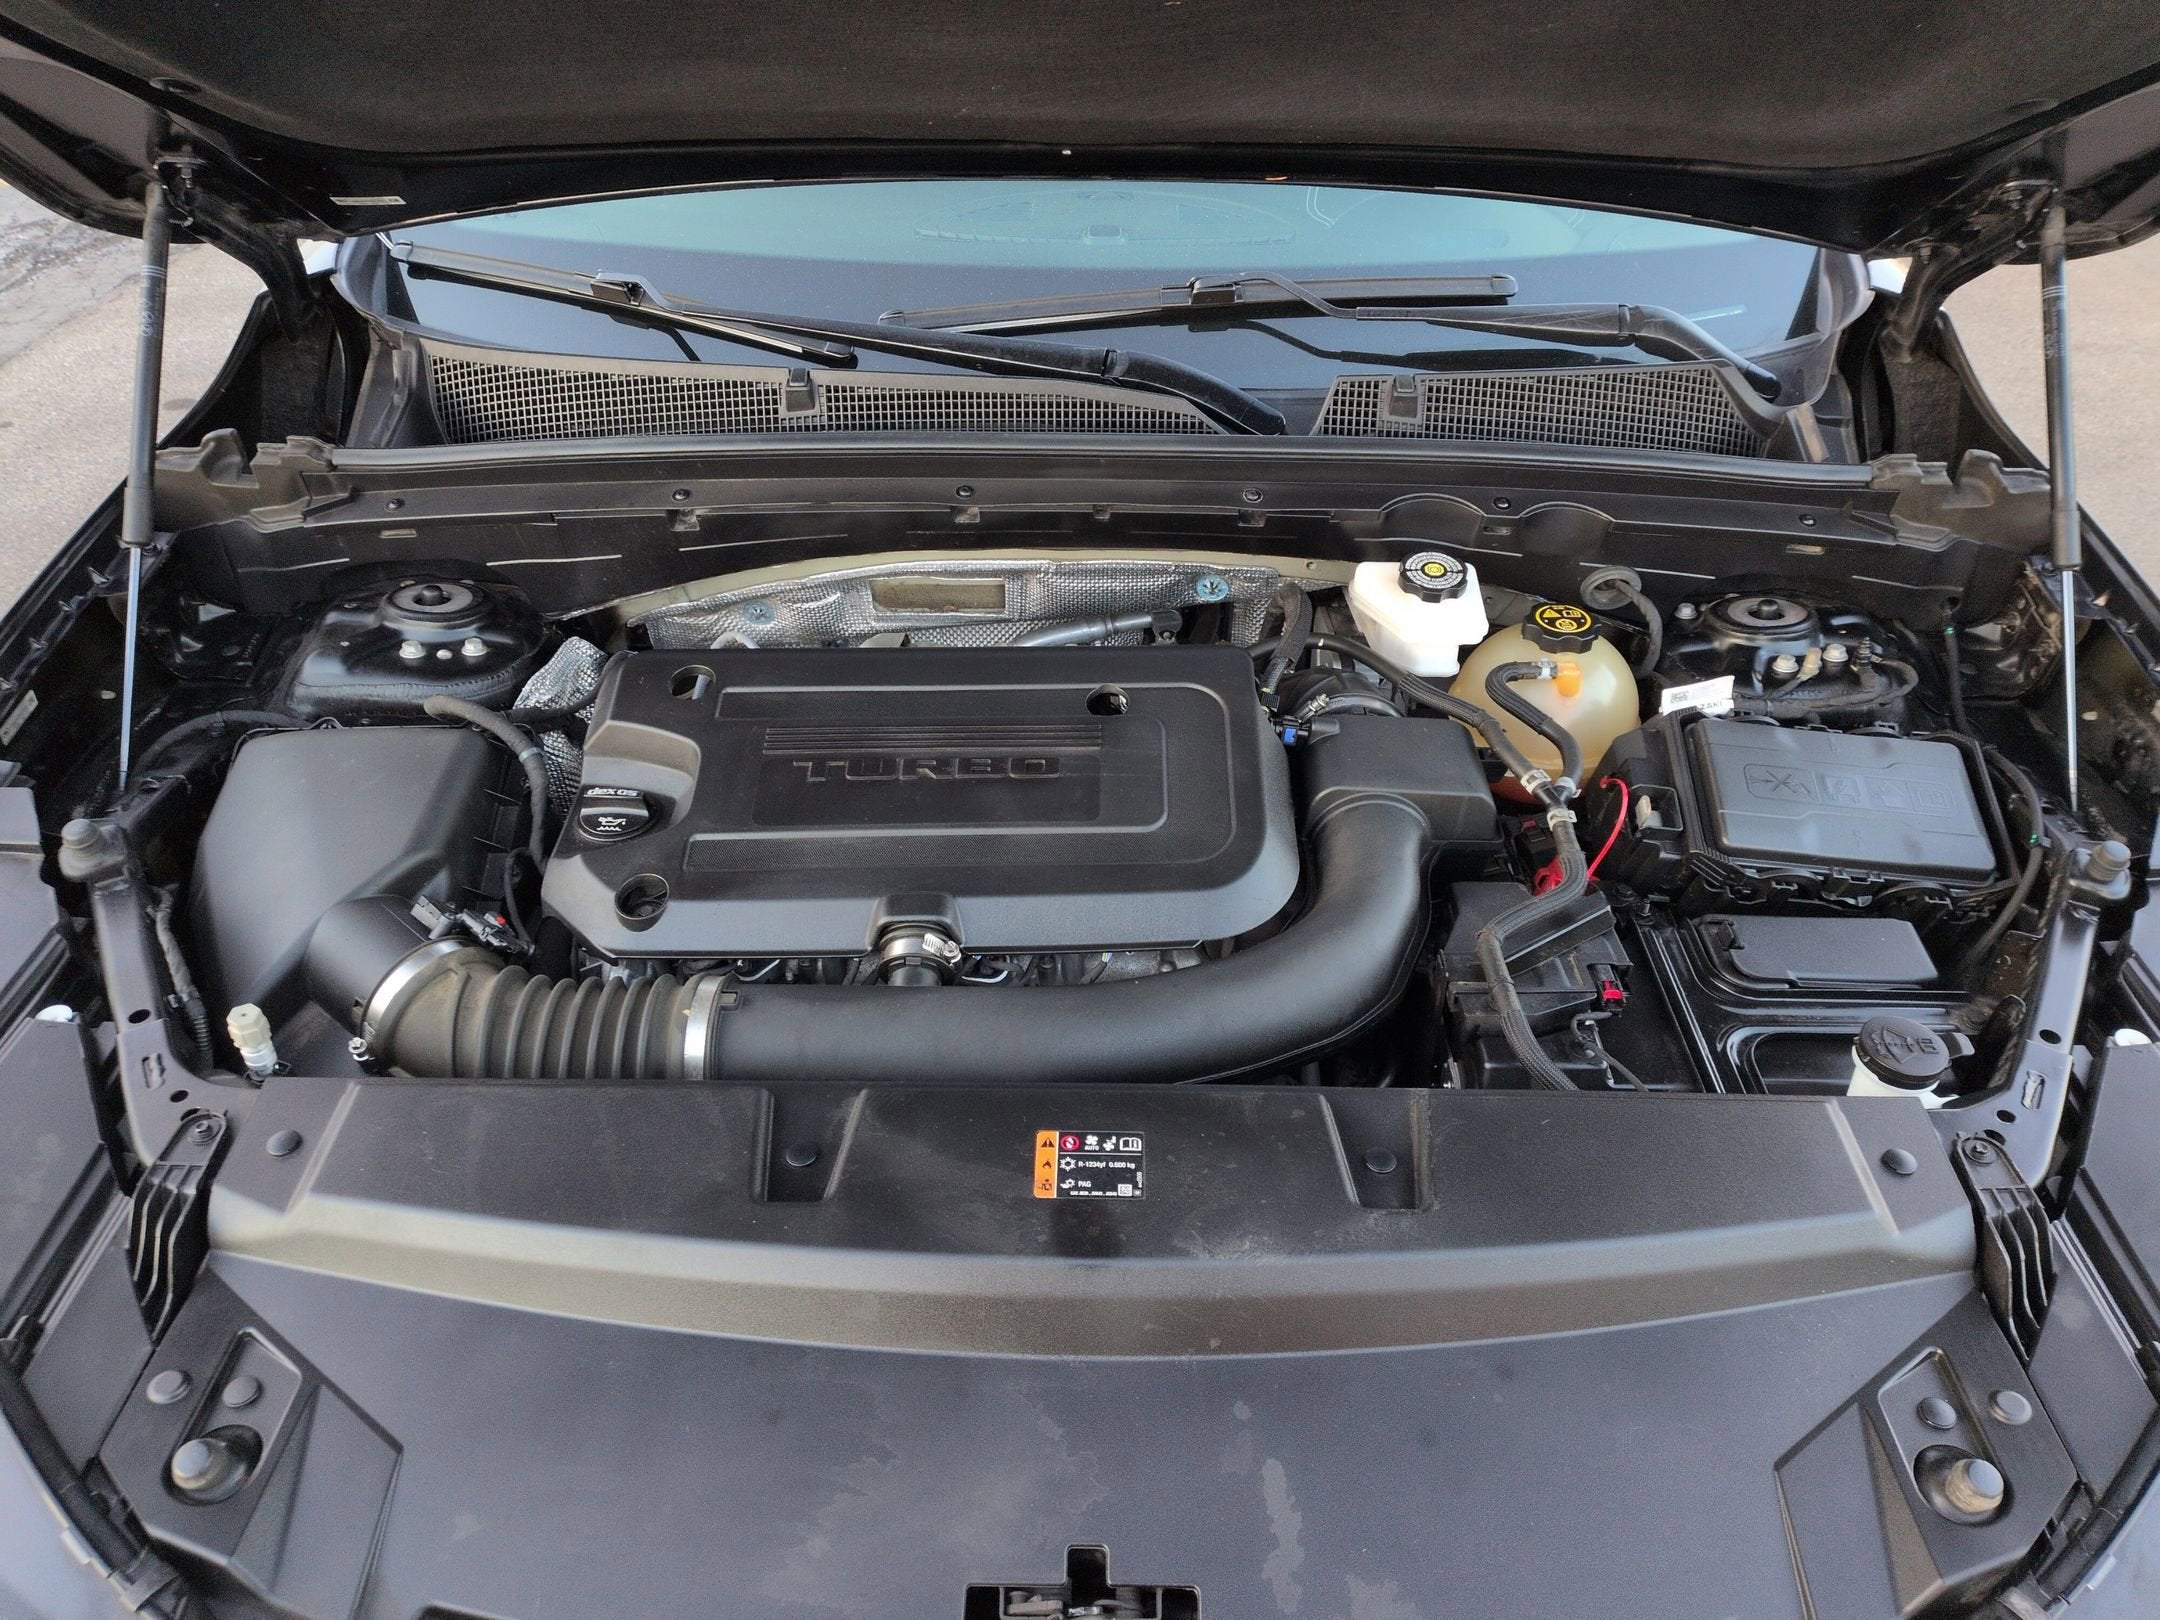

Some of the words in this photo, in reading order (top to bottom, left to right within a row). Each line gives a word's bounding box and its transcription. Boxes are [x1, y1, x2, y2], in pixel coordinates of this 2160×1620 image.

[793, 757, 1064, 782] TURBO
[1078, 1161, 1106, 1169] R-1234yf
[1127, 1161, 1135, 1169] kg
